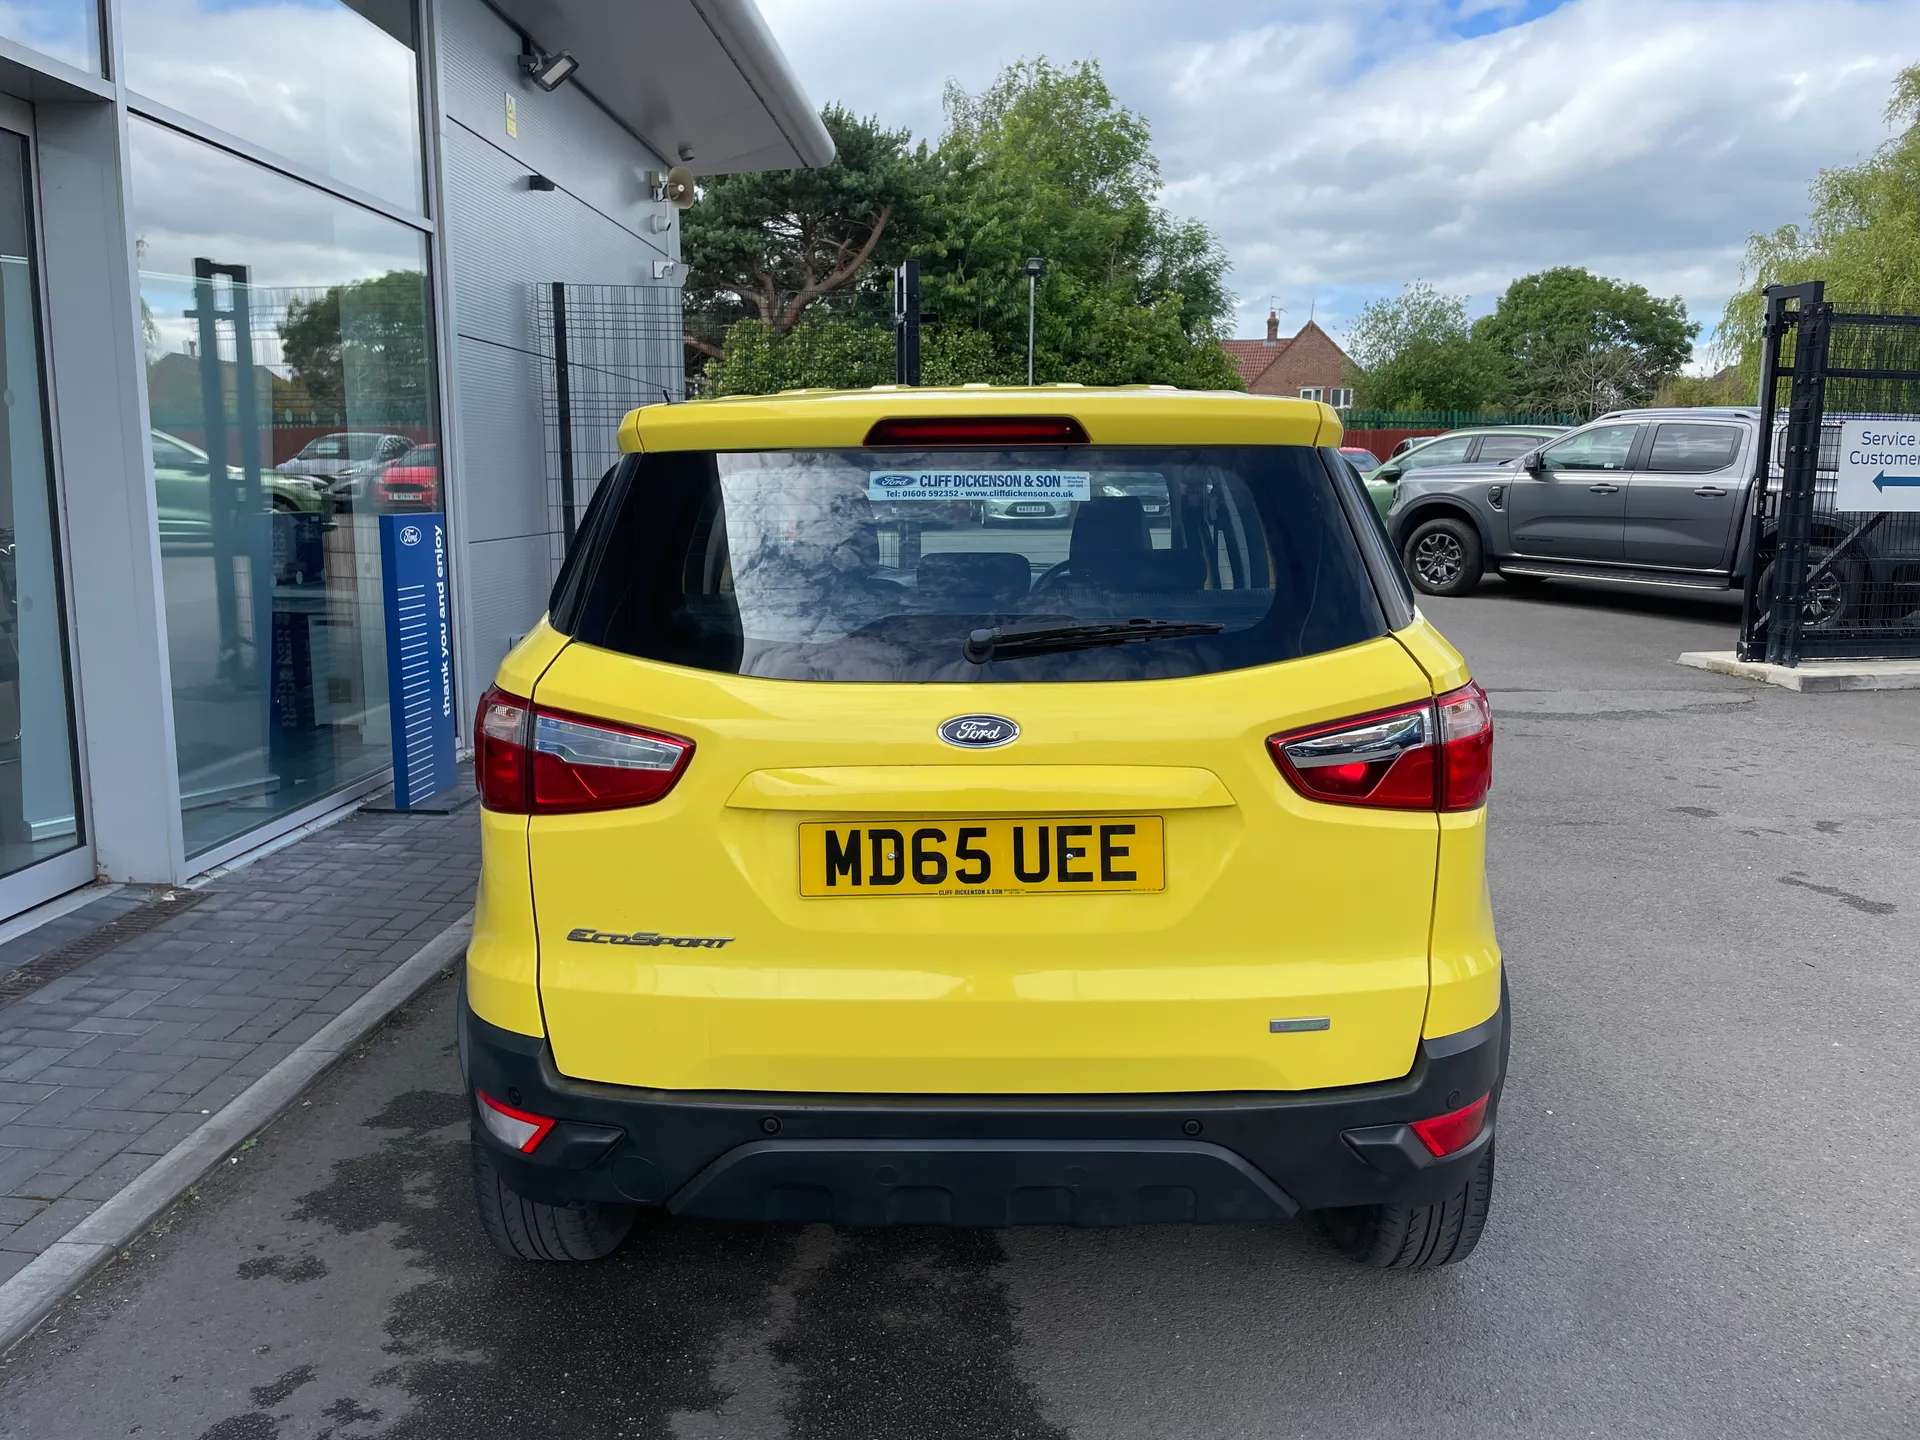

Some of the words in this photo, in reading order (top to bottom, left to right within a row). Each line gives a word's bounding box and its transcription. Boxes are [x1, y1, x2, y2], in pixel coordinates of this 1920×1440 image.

[1861, 431, 1916, 446] Service
[880, 475, 912, 487] Ford
[886, 489, 901, 498] Tel:
[928, 490, 959, 498] 592352
[965, 489, 1074, 498] www.cliffdickenson.co.uk
[920, 474, 952, 488] CLIFF
[953, 474, 1022, 488] DICKENSON
[1023, 474, 1034, 488] &
[1035, 475, 1061, 488] SON
[434, 524, 444, 578] enjoy
[436, 581, 446, 620] and
[440, 622, 449, 659] you
[441, 660, 451, 718] thank
[956, 719, 1001, 741] Ford
[825, 827, 991, 887] MD65
[1013, 824, 1137, 884] UEE
